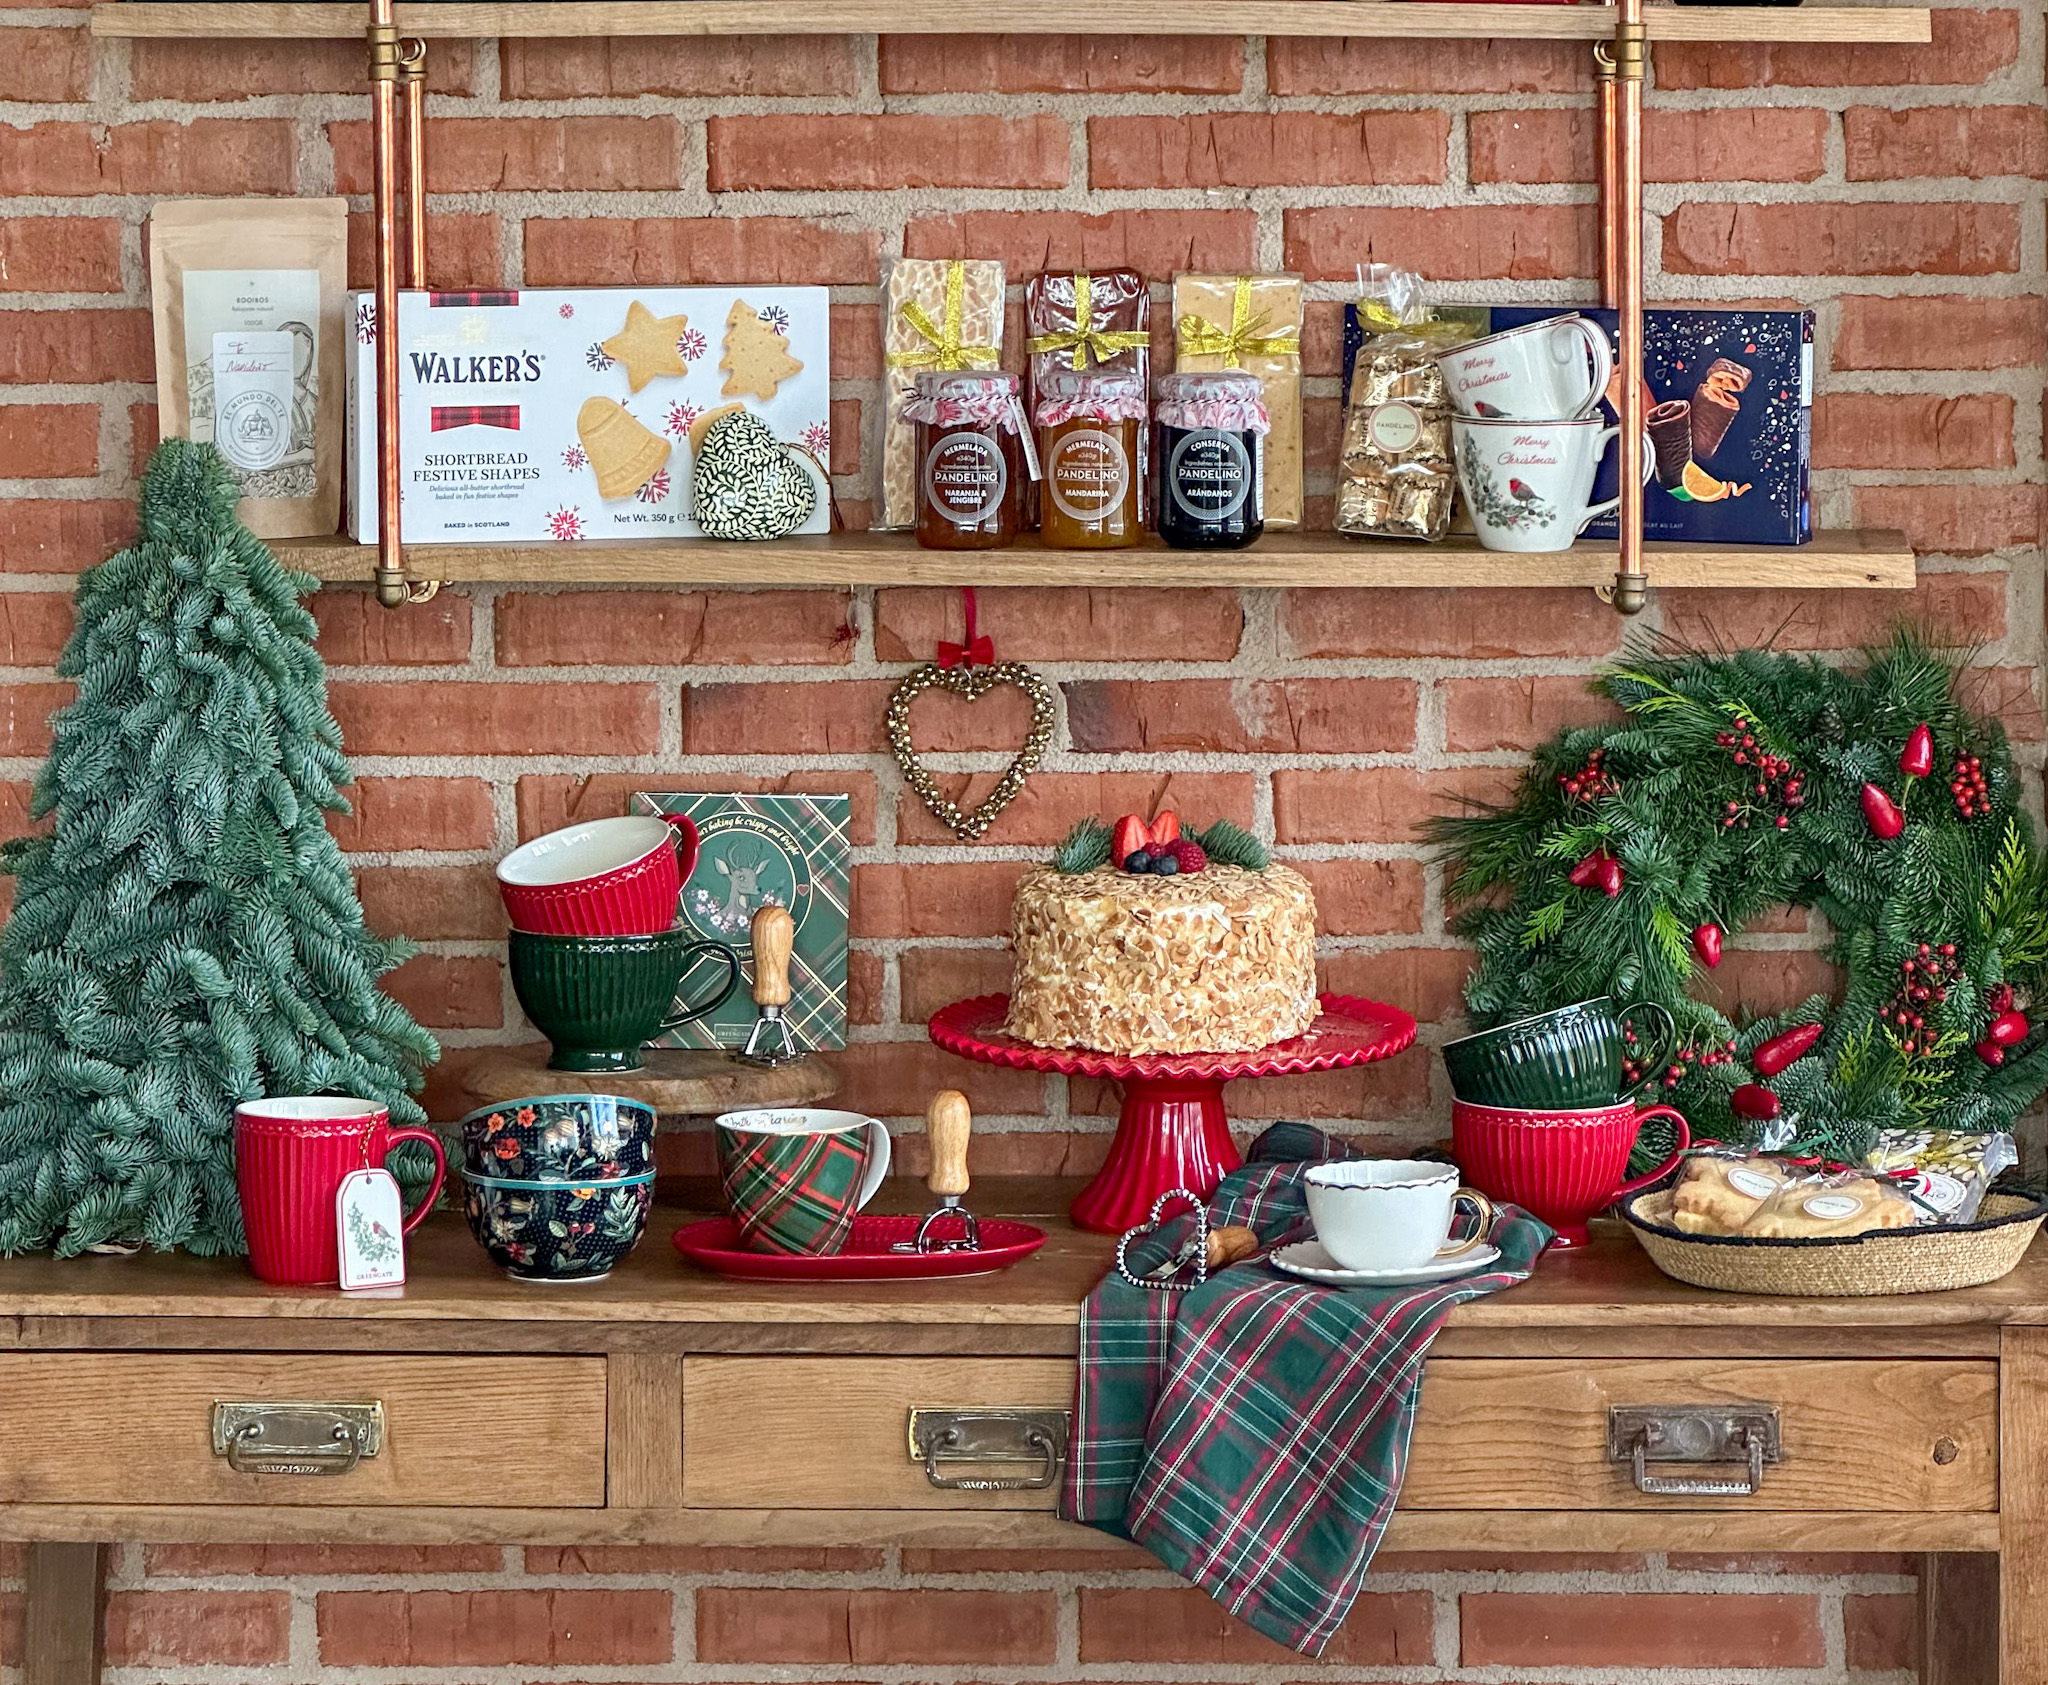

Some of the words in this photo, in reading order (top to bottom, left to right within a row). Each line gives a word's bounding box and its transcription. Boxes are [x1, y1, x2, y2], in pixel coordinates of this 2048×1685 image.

[409, 349, 541, 384] WALKER'S
[1463, 357, 1495, 371] Merry
[1458, 371, 1511, 392] Christmas
[230, 393, 263, 409] MUNDO
[265, 396, 278, 408] DEL
[1376, 422, 1416, 431] PANDELINO
[1066, 440, 1109, 454] MERMELADA
[1190, 440, 1230, 452] CONSERVA
[1513, 435, 1550, 448] Merry
[944, 443, 988, 457] MERMELADA
[424, 452, 528, 467] SHORTBREAD
[1498, 451, 1558, 465] Christmas
[413, 469, 478, 482] FESTIVE
[480, 467, 540, 481] SHAPES
[935, 473, 998, 482] PANDELINO
[1057, 469, 1119, 479] PANDELINO
[1179, 468, 1241, 479] PANDELINO
[490, 482, 525, 490] shortbread
[463, 492, 475, 501] fun
[475, 491, 497, 500] festive
[497, 491, 519, 499] shapes
[1065, 489, 1109, 497] MANDARINA
[1187, 488, 1232, 497] ARÁNDANOS
[614, 514, 630, 523] Net
[632, 514, 649, 522] Wt.
[651, 513, 667, 522] 350
[668, 515, 675, 524] g
[708, 817, 734, 832] baking
[744, 818, 768, 832] crispy
[767, 826, 784, 838] and
[780, 835, 800, 856] bright
[356, 1271, 393, 1280] GREENGATE
